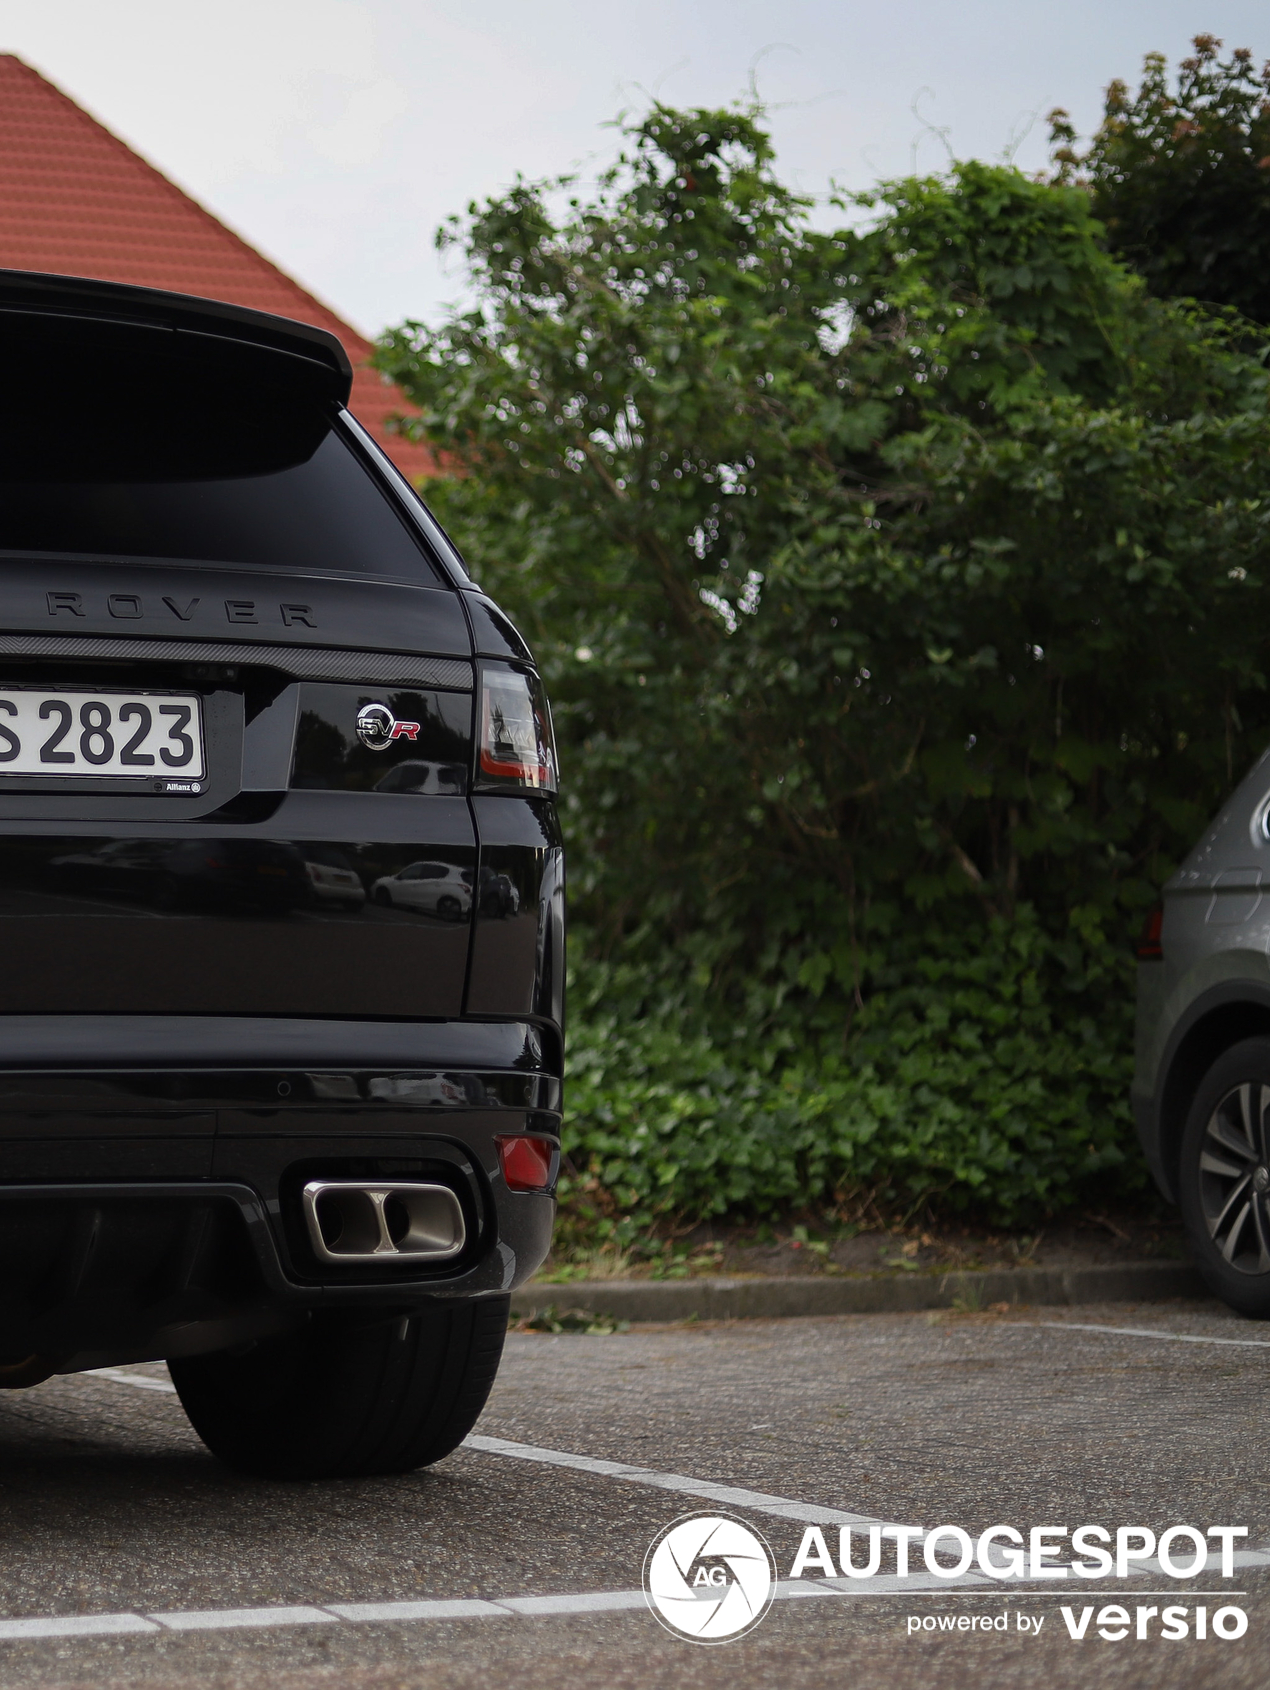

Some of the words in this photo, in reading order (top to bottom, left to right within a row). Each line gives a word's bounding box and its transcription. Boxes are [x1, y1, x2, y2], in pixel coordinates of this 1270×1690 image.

[46, 591, 318, 629] ROVER
[38, 699, 194, 768] 2823
[357, 717, 421, 741] SVR
[166, 783, 191, 791] Allianz
